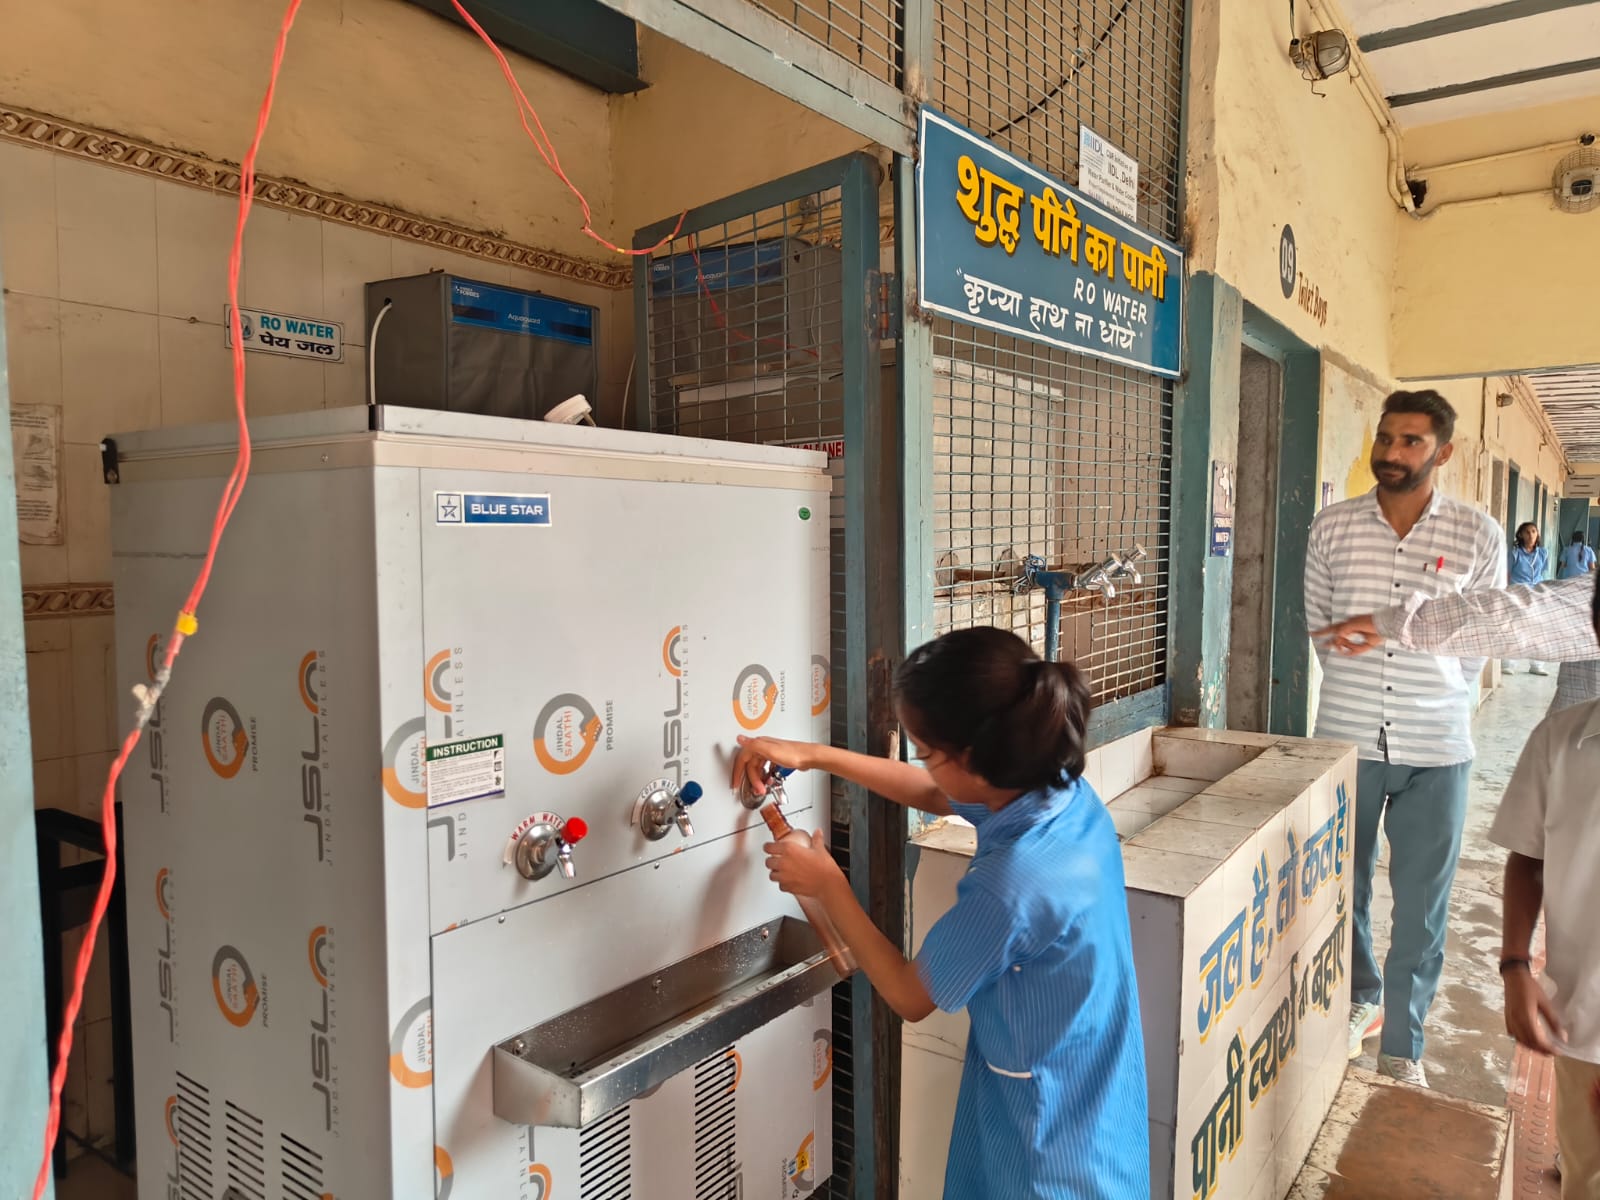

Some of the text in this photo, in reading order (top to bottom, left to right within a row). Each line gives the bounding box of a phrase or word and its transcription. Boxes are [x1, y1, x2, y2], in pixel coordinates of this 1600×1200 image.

[956, 155, 1025, 254] शुद्ध
[1030, 186, 1081, 263] पीने
[1084, 223, 1116, 279] का
[1121, 245, 1168, 299] पानी
[1281, 237, 1294, 284] 09
[1030, 296, 1069, 332] हाथ
[1074, 312, 1094, 339] ना
[1074, 277, 1147, 325] RO WATER
[259, 331, 335, 355] पेय जल
[260, 315, 334, 339] RO WATER
[471, 503, 543, 516] BLUE STAR
[455, 647, 464, 737] AINLESS
[433, 737, 499, 758] INSTRUCTION
[564, 710, 572, 756] SAATHI
[411, 743, 420, 783] JINDAL
[301, 715, 323, 862] JSL
[459, 813, 467, 859] JIND
[511, 812, 563, 840] WARM WATE
[1197, 906, 1248, 1038] जल
[1276, 825, 1299, 937] तो
[1301, 813, 1336, 901] कल
[310, 989, 331, 1132] JSL
[1191, 1032, 1246, 1200] पानी
